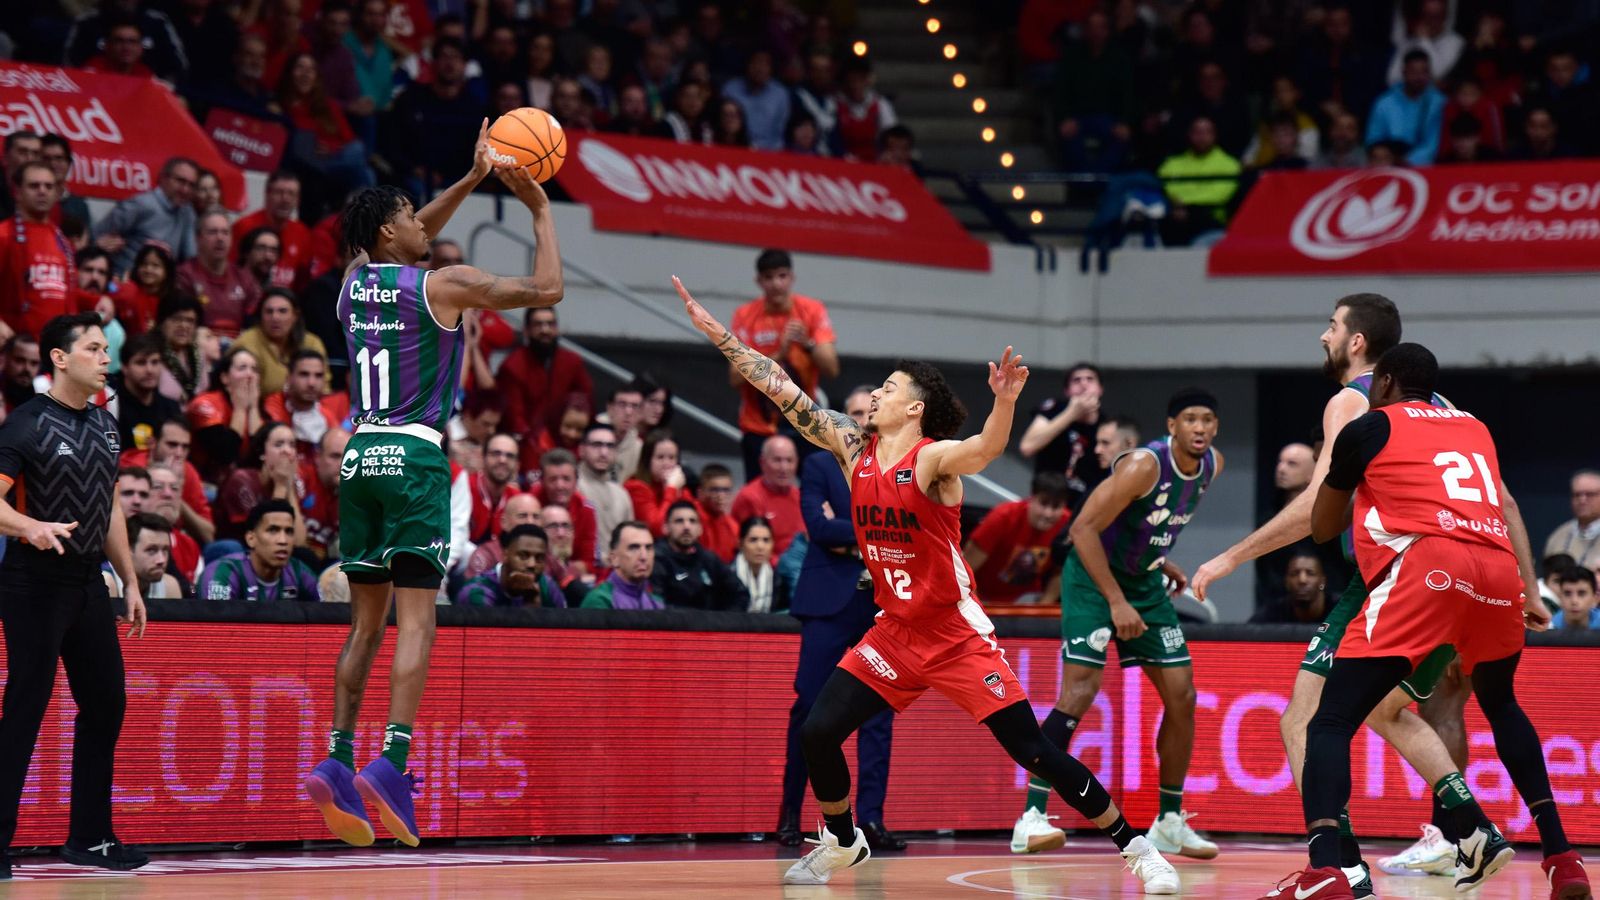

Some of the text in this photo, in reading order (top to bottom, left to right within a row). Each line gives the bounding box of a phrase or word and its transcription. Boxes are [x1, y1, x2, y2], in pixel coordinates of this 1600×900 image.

[636, 154, 907, 222] INMOKING
[1447, 181, 1520, 214] OC
[350, 280, 402, 303] Carter
[356, 347, 390, 410] 11
[361, 456, 405, 467] DEL SOL
[363, 444, 406, 457] COSTA
[361, 466, 404, 477] MÁLAGA
[1433, 451, 1499, 507] 21
[855, 504, 921, 531] UCAM
[865, 529, 913, 544] MURCIA
[883, 568, 913, 600] 12
[1475, 594, 1487, 603] DE
[1486, 597, 1512, 607] MURCIA
[865, 650, 899, 681] ESP
